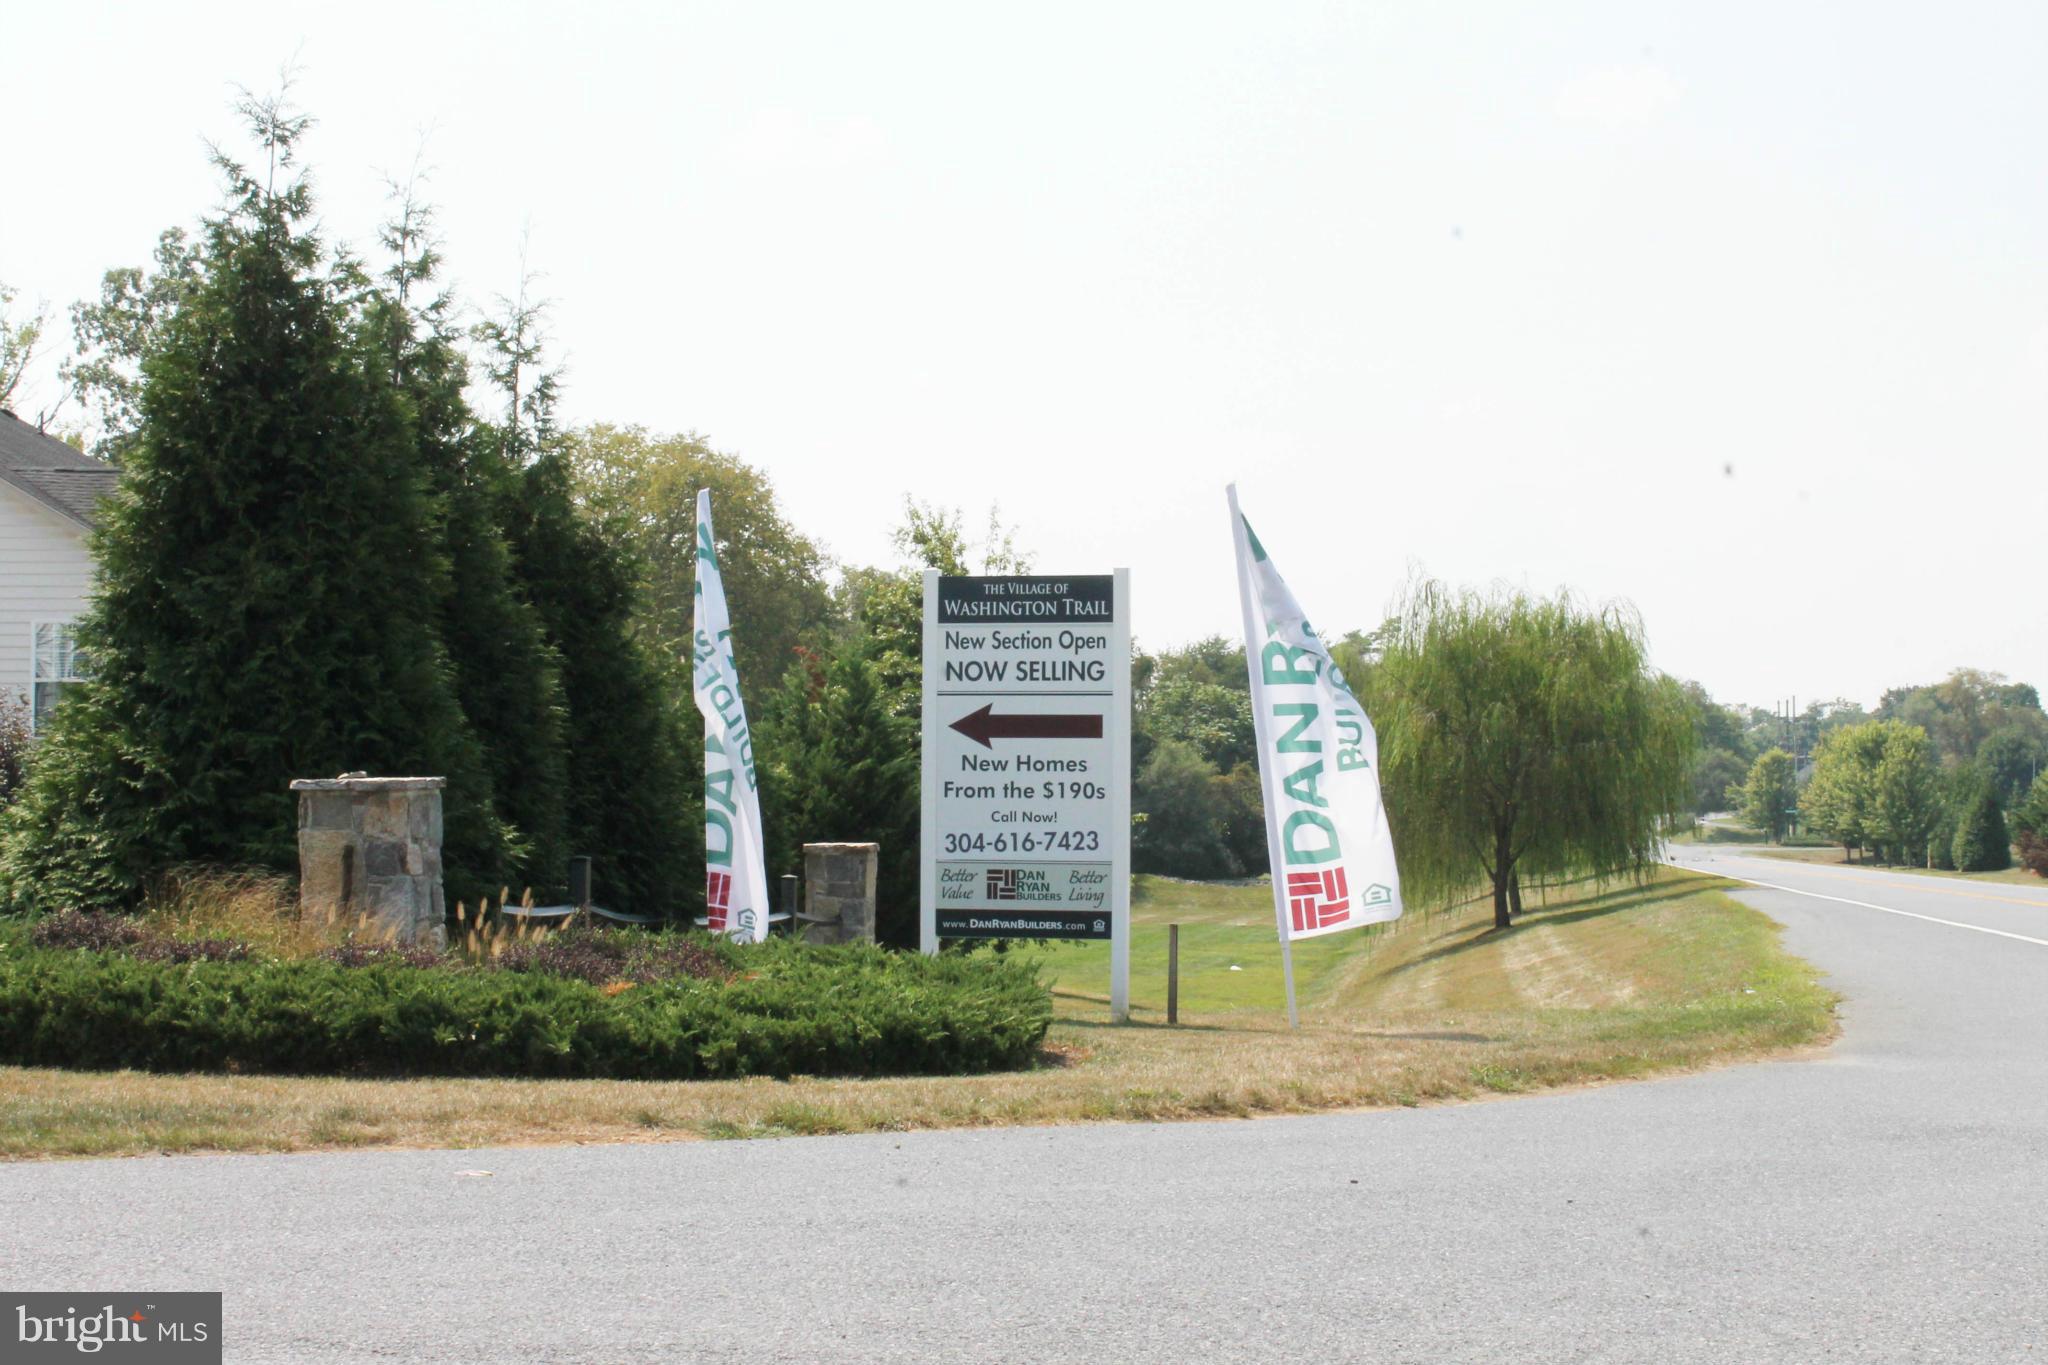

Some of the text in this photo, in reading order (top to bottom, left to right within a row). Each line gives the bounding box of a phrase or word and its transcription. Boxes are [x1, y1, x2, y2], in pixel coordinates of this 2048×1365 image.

[984, 582, 1069, 595] THE VILLAGE OF
[944, 598, 1109, 616] WASHINGTON TRAIL
[945, 630, 1106, 655] New Section Open
[945, 660, 1105, 682] NOW SELLING
[961, 754, 1087, 772] New Homes
[944, 781, 1105, 800] From the $190s
[1273, 703, 1342, 866] DAN
[991, 811, 1058, 823] Call Now!
[944, 831, 1099, 853] 304-616-7423
[941, 868, 978, 882] Better
[1016, 869, 1045, 881] DAN
[1069, 870, 1108, 884] Better
[941, 884, 974, 900] Value
[1016, 881, 1050, 892] RYAN
[1016, 892, 1062, 901] BUILDERS
[1068, 887, 1105, 909] Living
